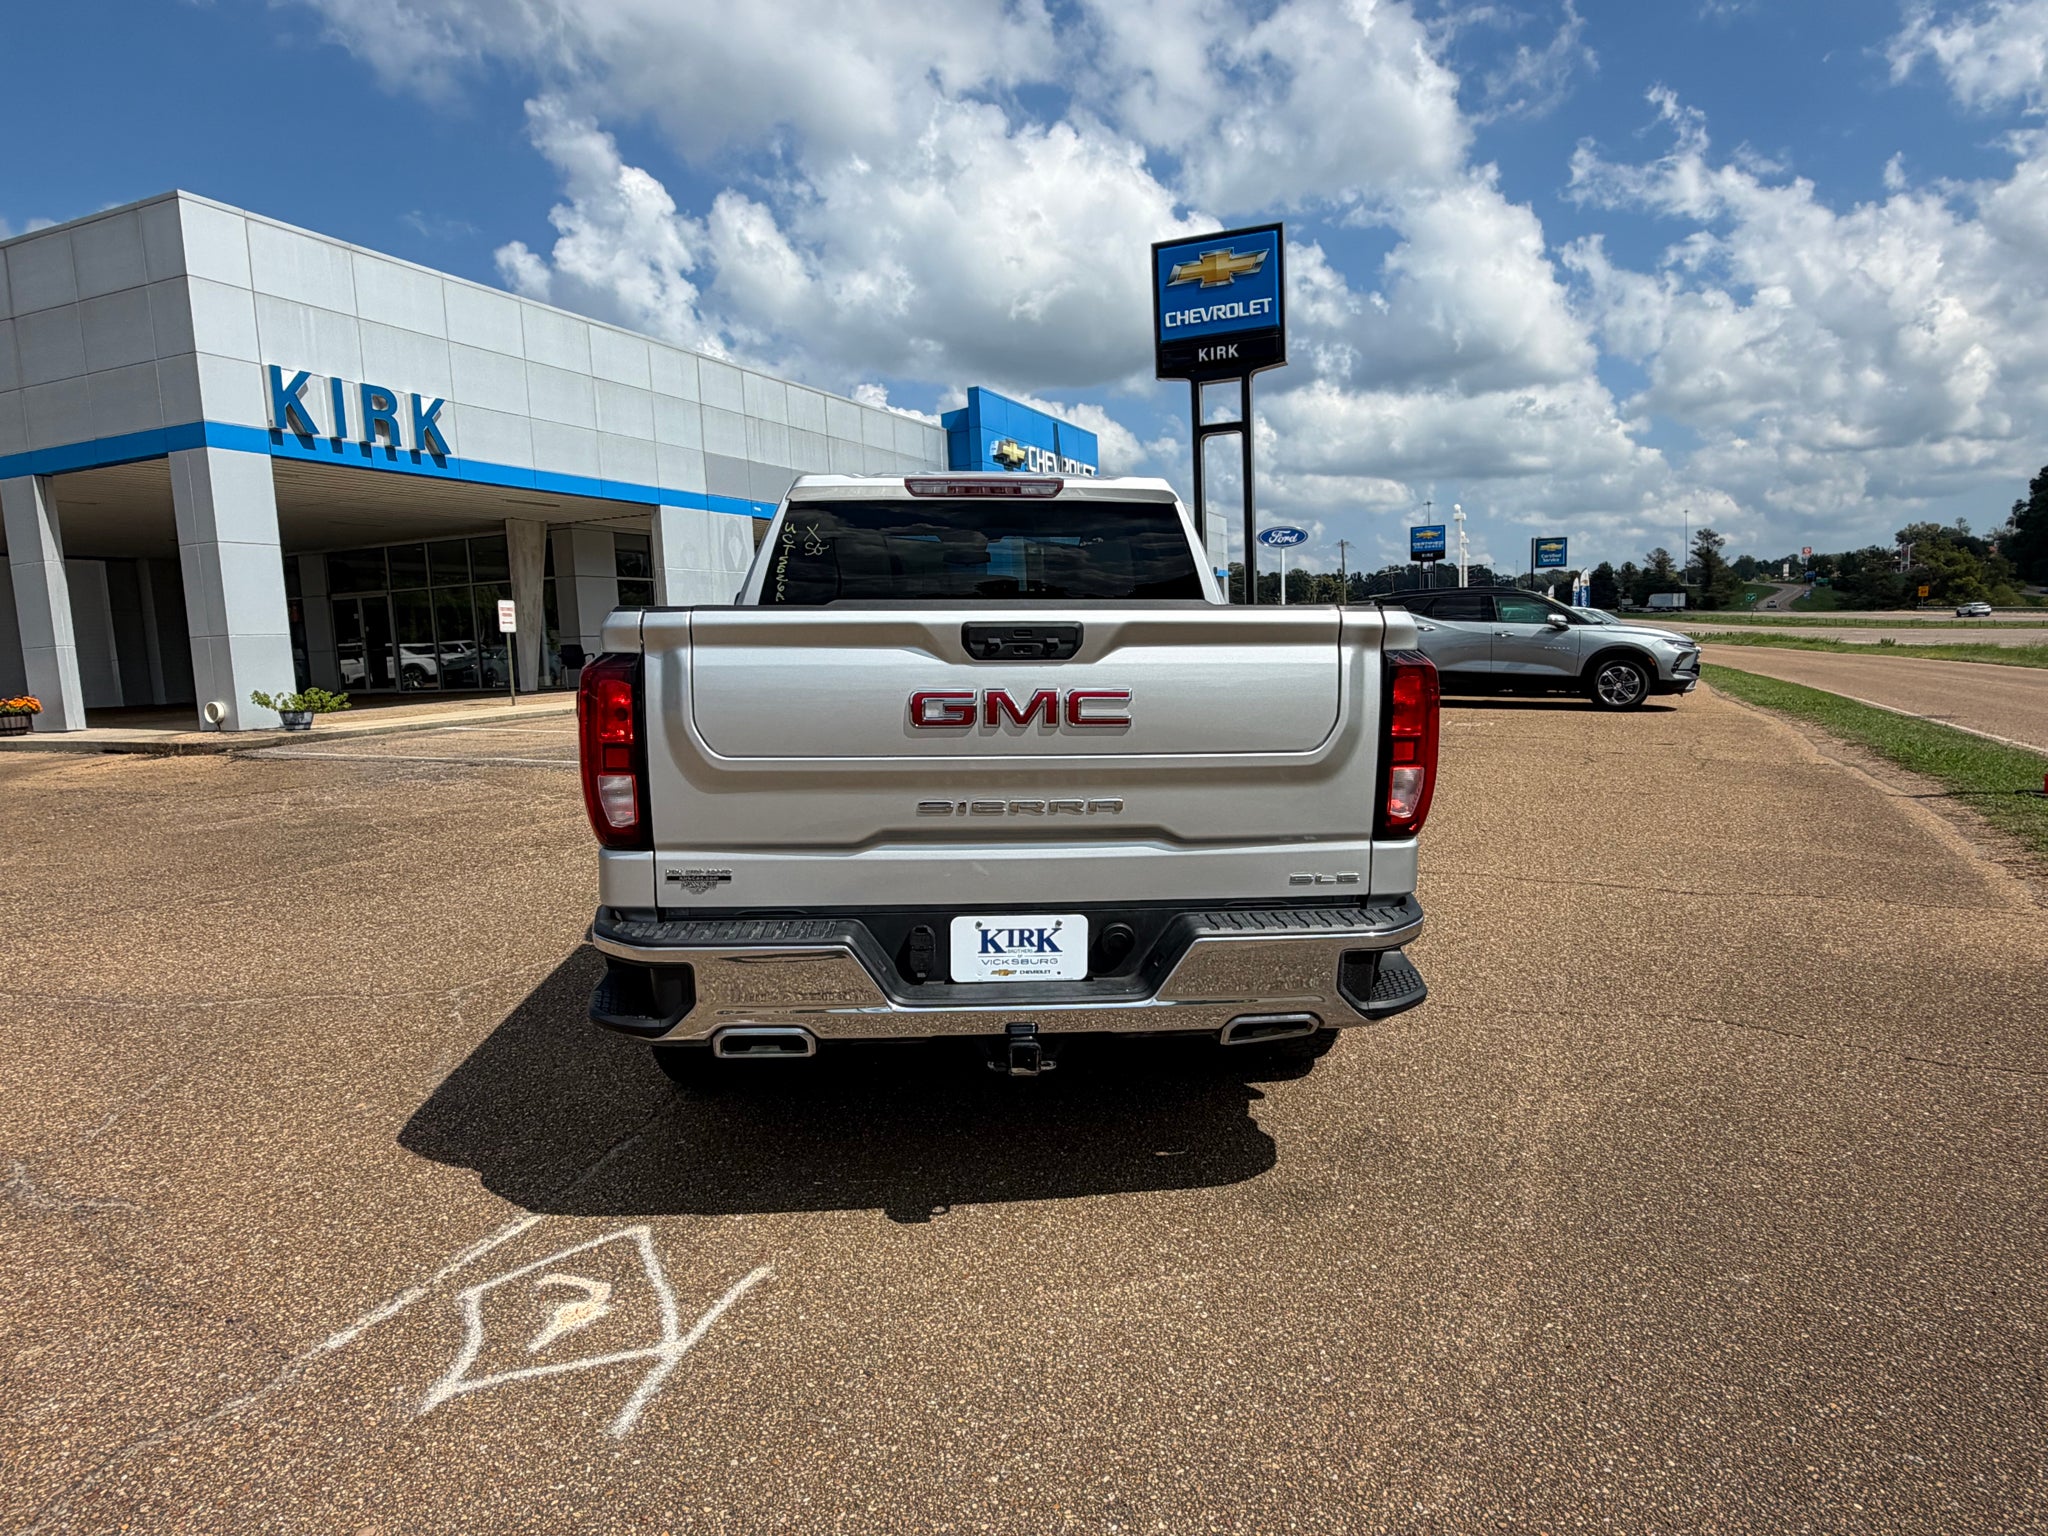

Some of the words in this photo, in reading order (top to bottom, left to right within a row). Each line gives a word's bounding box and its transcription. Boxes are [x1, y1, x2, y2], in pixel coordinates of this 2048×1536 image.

[1165, 298, 1272, 328] CHEVROLET
[1198, 344, 1239, 362] KIRK
[266, 364, 452, 455] KIRK
[1268, 530, 1299, 544] Ford
[909, 688, 1133, 728] GMC
[917, 799, 1124, 816] SIERRA
[1289, 871, 1361, 885] SLE
[978, 928, 1063, 954] KIRK
[981, 958, 1059, 966] VICKSBURG
